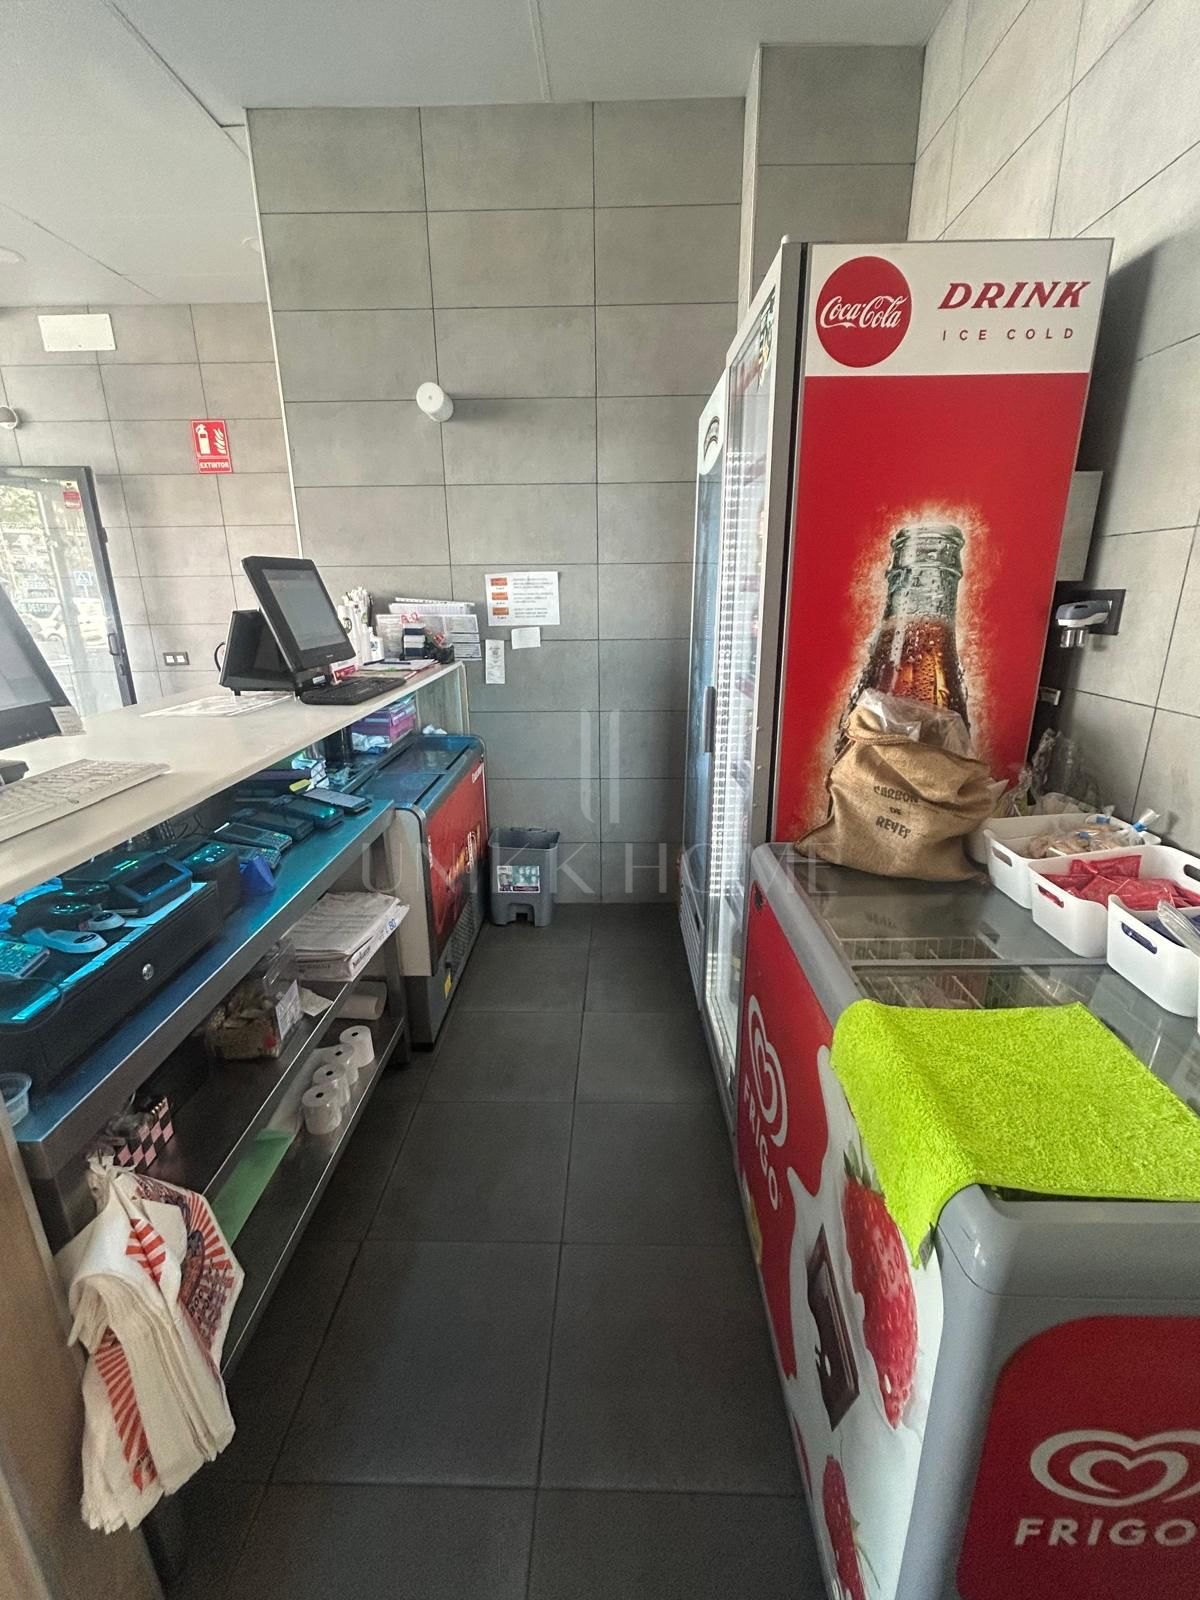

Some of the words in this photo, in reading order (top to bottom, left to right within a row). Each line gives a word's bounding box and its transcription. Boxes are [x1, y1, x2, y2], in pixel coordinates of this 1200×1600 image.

[937, 280, 1091, 310] DRINK
[819, 295, 909, 329] Coca-Cola
[941, 329, 987, 341] ICE
[1006, 327, 1074, 340] COLD
[875, 815, 911, 839] REYES
[743, 1072, 779, 1212] FRIGO
[1014, 1517, 1198, 1547] FRIGO
